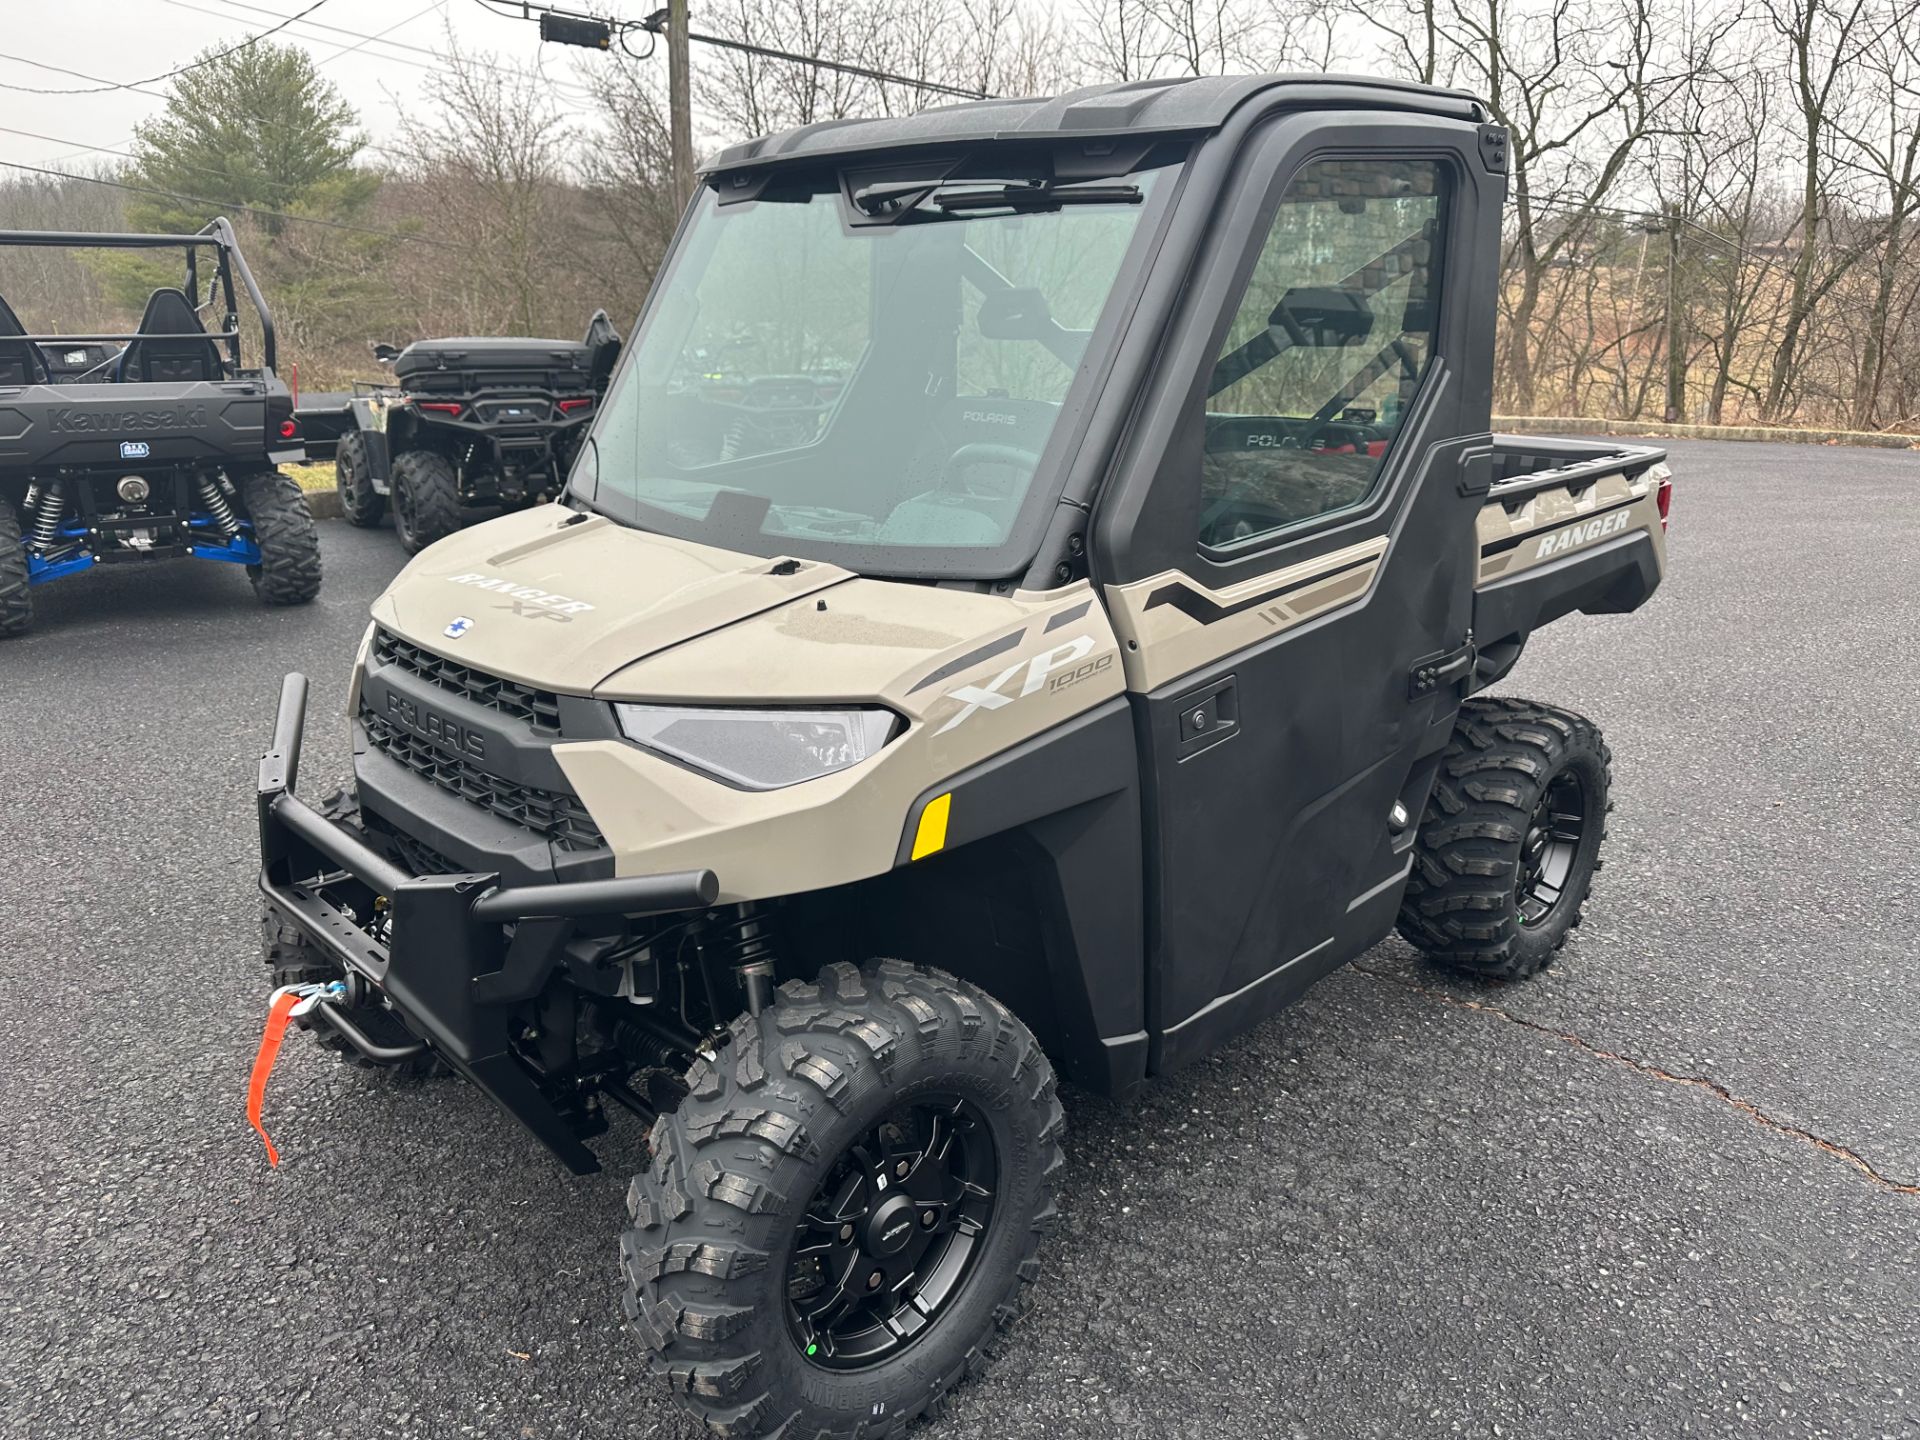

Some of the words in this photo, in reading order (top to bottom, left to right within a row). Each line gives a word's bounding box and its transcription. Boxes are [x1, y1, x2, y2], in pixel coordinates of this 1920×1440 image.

[47, 404, 208, 433] Kawasaki
[962, 410, 1017, 426] POLARIS
[1535, 510, 1631, 560] RANGER
[447, 573, 596, 615] RANGER
[490, 601, 573, 623] XP
[930, 634, 1096, 738] XP
[1049, 654, 1113, 690] 1000
[386, 689, 486, 761] POLARIS
